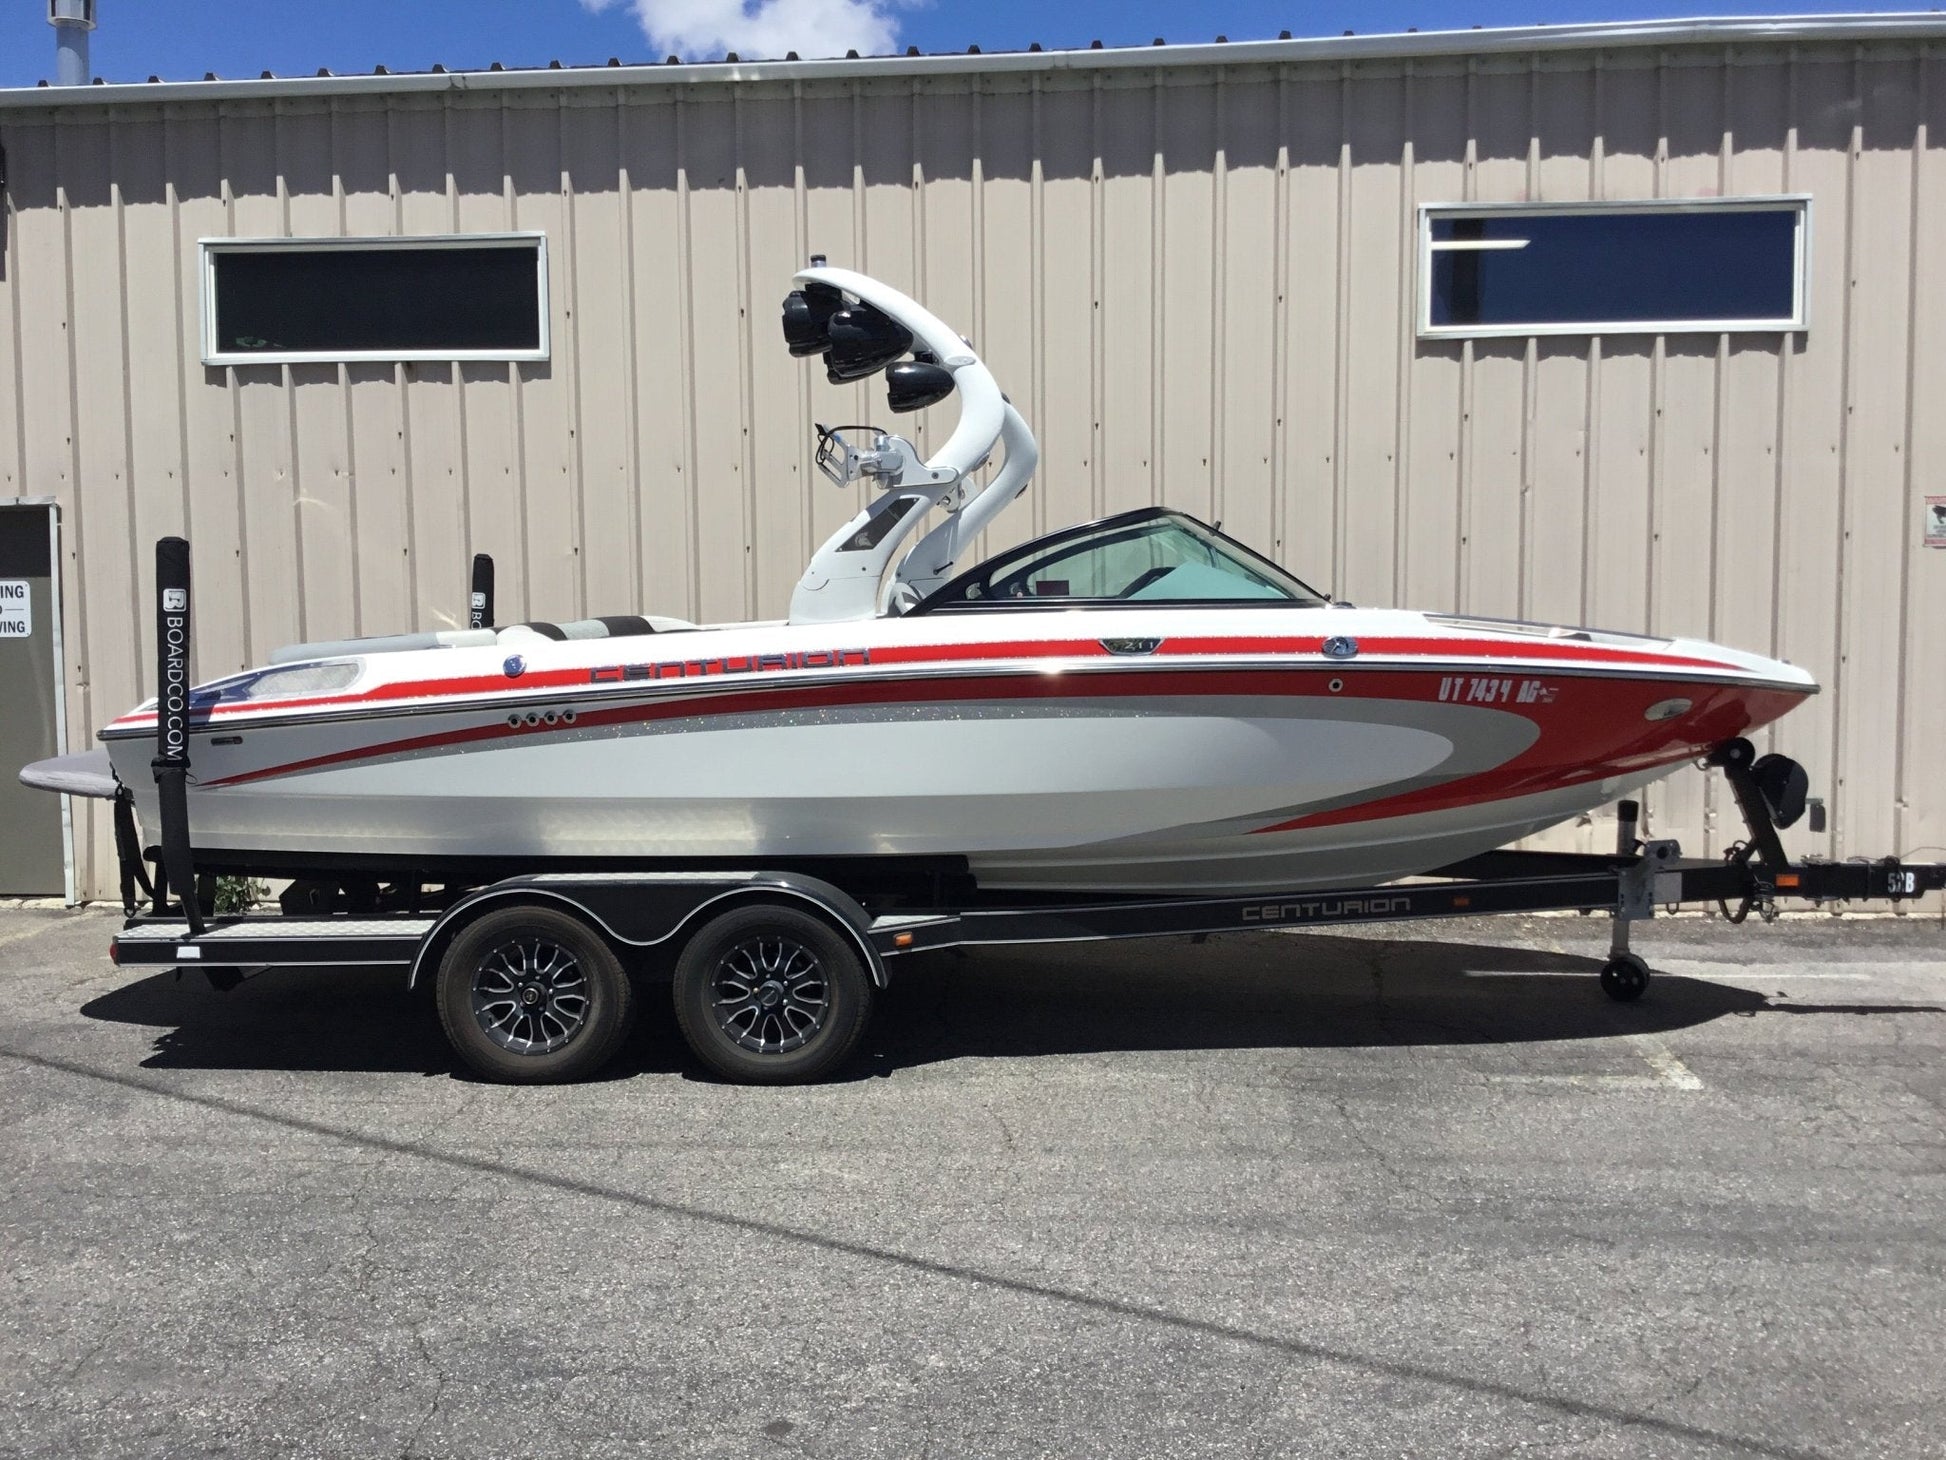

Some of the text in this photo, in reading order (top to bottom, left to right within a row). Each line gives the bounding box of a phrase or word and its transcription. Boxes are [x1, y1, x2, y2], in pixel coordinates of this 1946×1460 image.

[590, 649, 868, 682] CENTURION
[166, 617, 183, 761] BOARDCO.COM
[1438, 677, 1464, 701] UT
[1242, 898, 1411, 921] CENTURION
